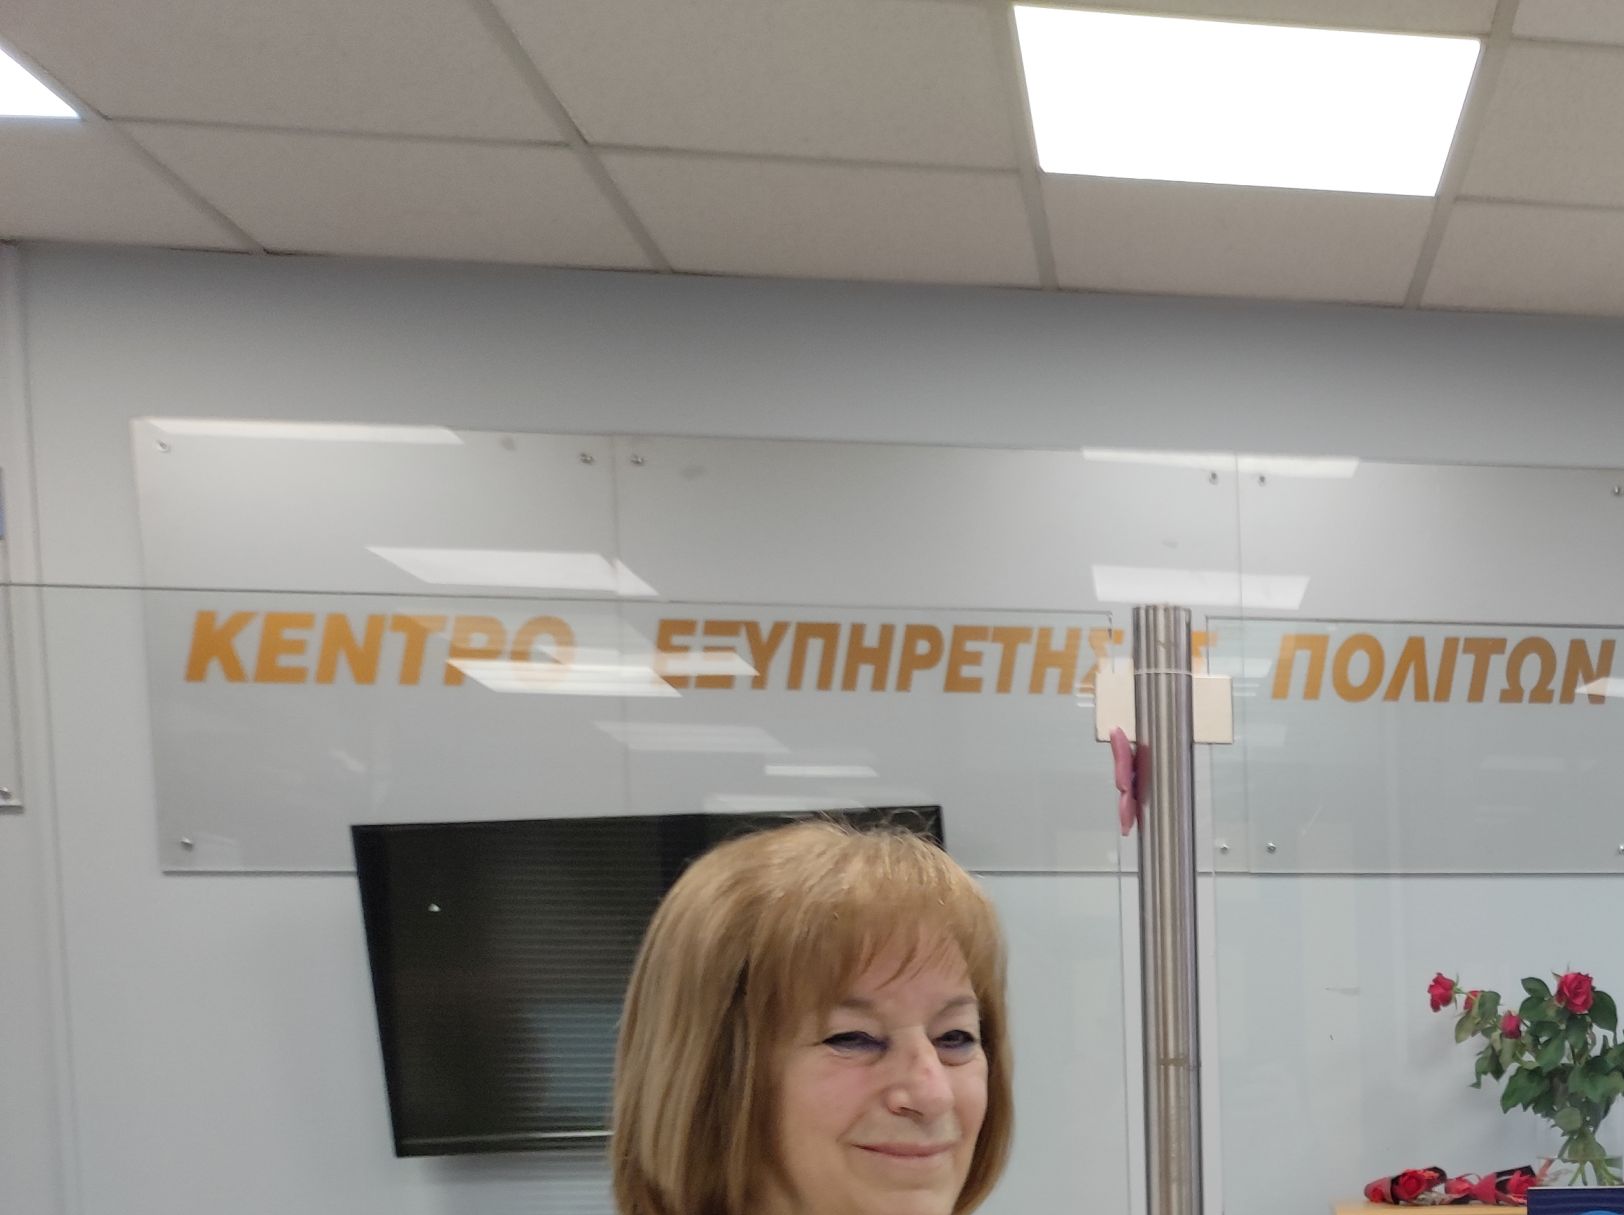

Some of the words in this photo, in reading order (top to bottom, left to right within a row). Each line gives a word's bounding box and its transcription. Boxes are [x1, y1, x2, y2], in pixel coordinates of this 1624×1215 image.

[184, 611, 576, 688] ΚΕΝΤΡΟ
[654, 618, 1218, 695] ΕΞΥΠΗΡΕΤΗΣ
[1271, 633, 1617, 706] ΠΟΛΙΤΩΝ
